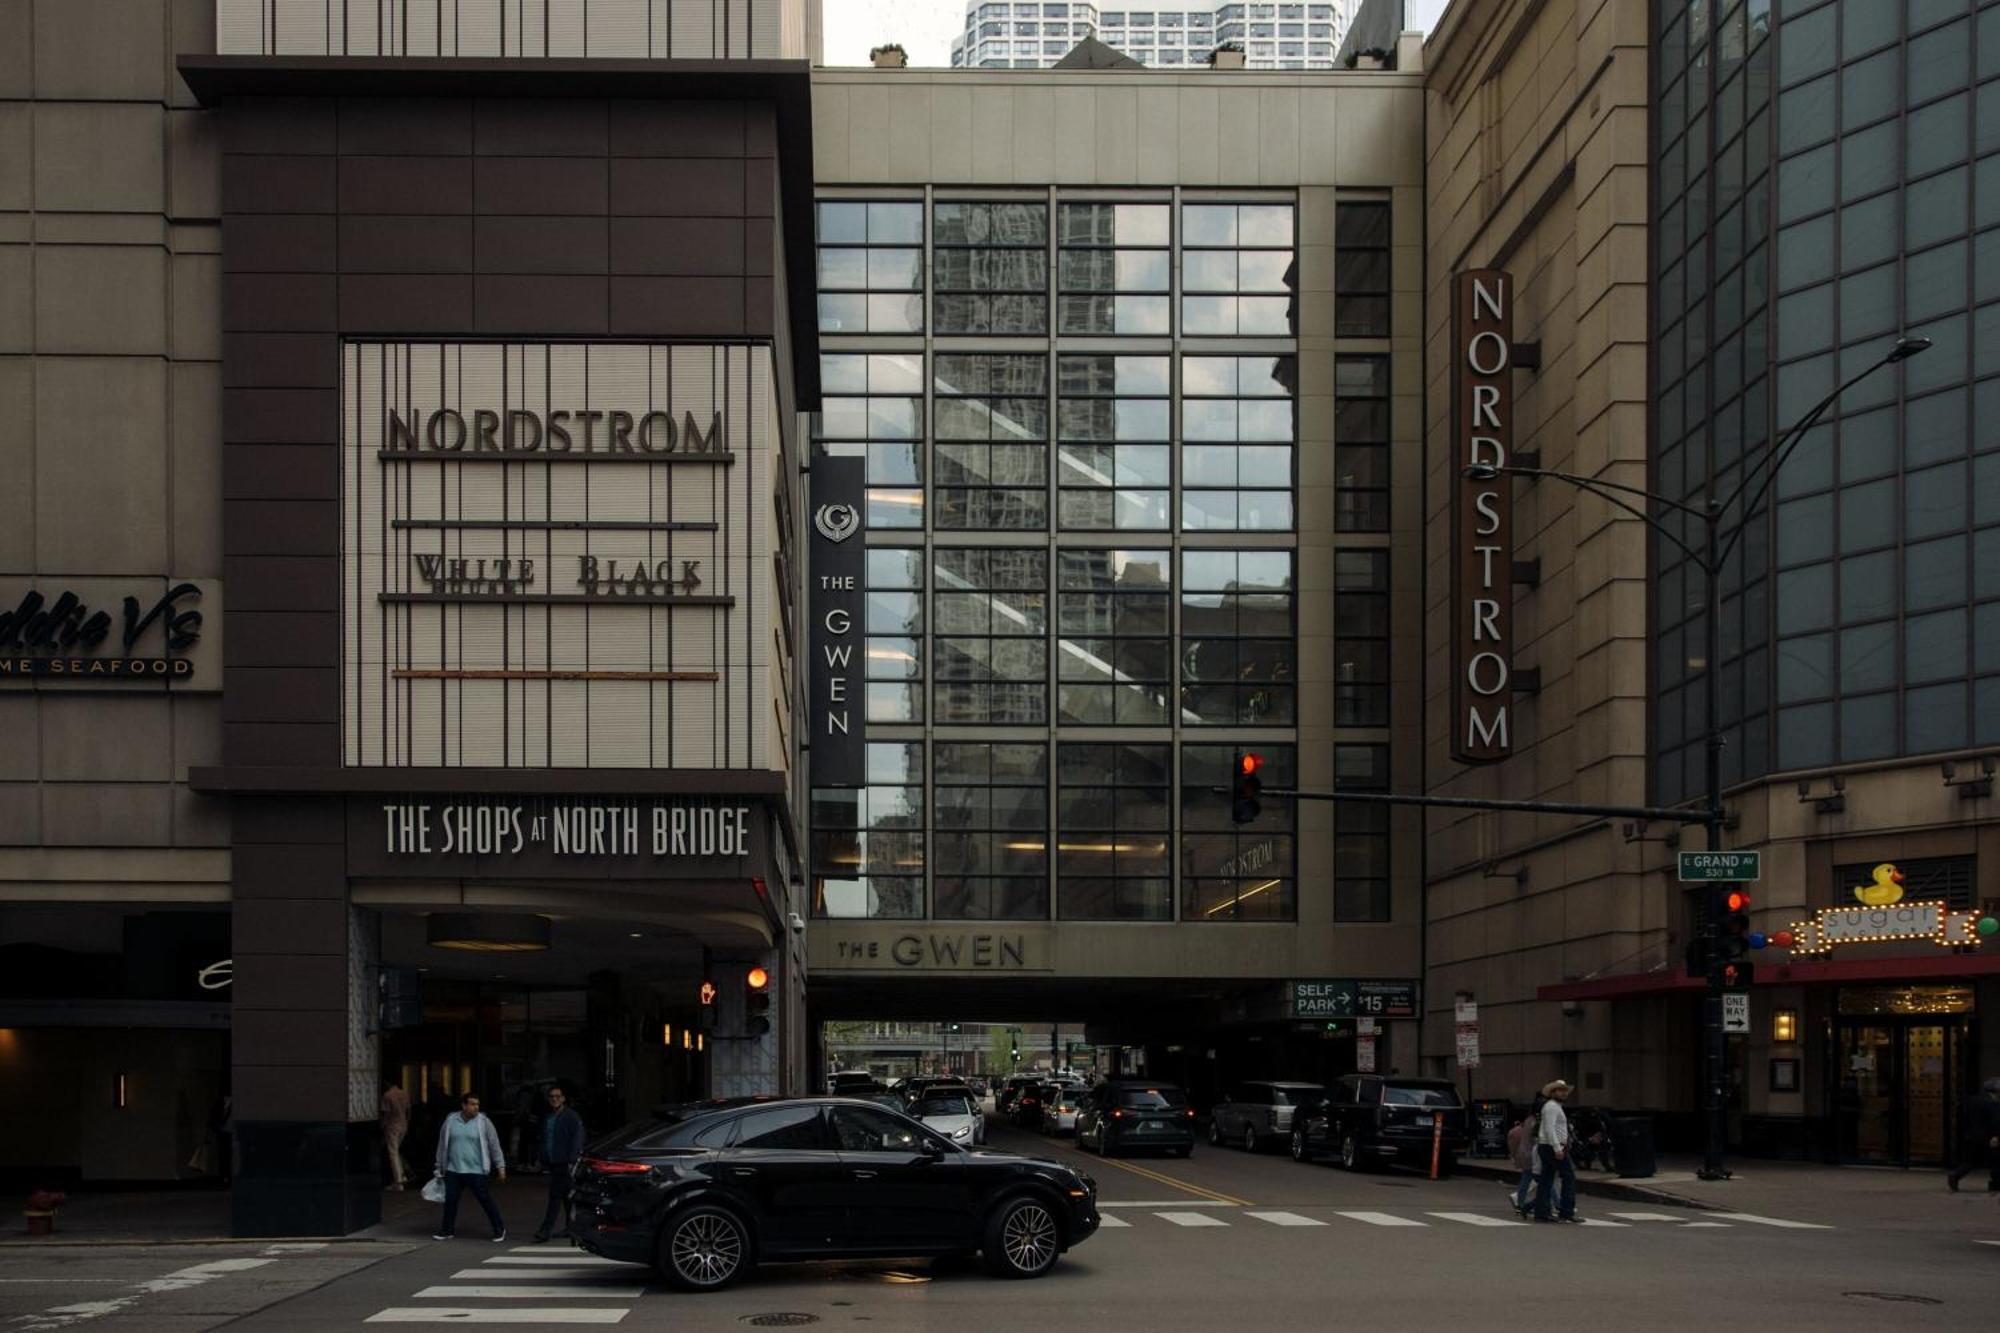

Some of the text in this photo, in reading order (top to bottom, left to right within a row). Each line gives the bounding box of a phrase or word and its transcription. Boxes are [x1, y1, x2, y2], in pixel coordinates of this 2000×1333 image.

[389, 408, 724, 455] NORDSTROM
[1467, 278, 1509, 749] NORDSTROM
[414, 553, 702, 586] WHITE BLACK
[821, 576, 854, 591] THE
[51, 659, 188, 673] SEAFOOD
[824, 608, 852, 735] GWEN
[384, 805, 750, 856] THE SHOPS AT NORTH BRIDGE
[1694, 855, 1740, 867] GRAND
[1743, 856, 1754, 865] AV
[1828, 904, 1933, 929] sugar
[837, 935, 1025, 967] THE GWEN
[1298, 984, 1333, 996] SELF
[1298, 999, 1337, 1011] PARK
[1727, 996, 1744, 1006] ONE
[1727, 1007, 1744, 1016] WAY
